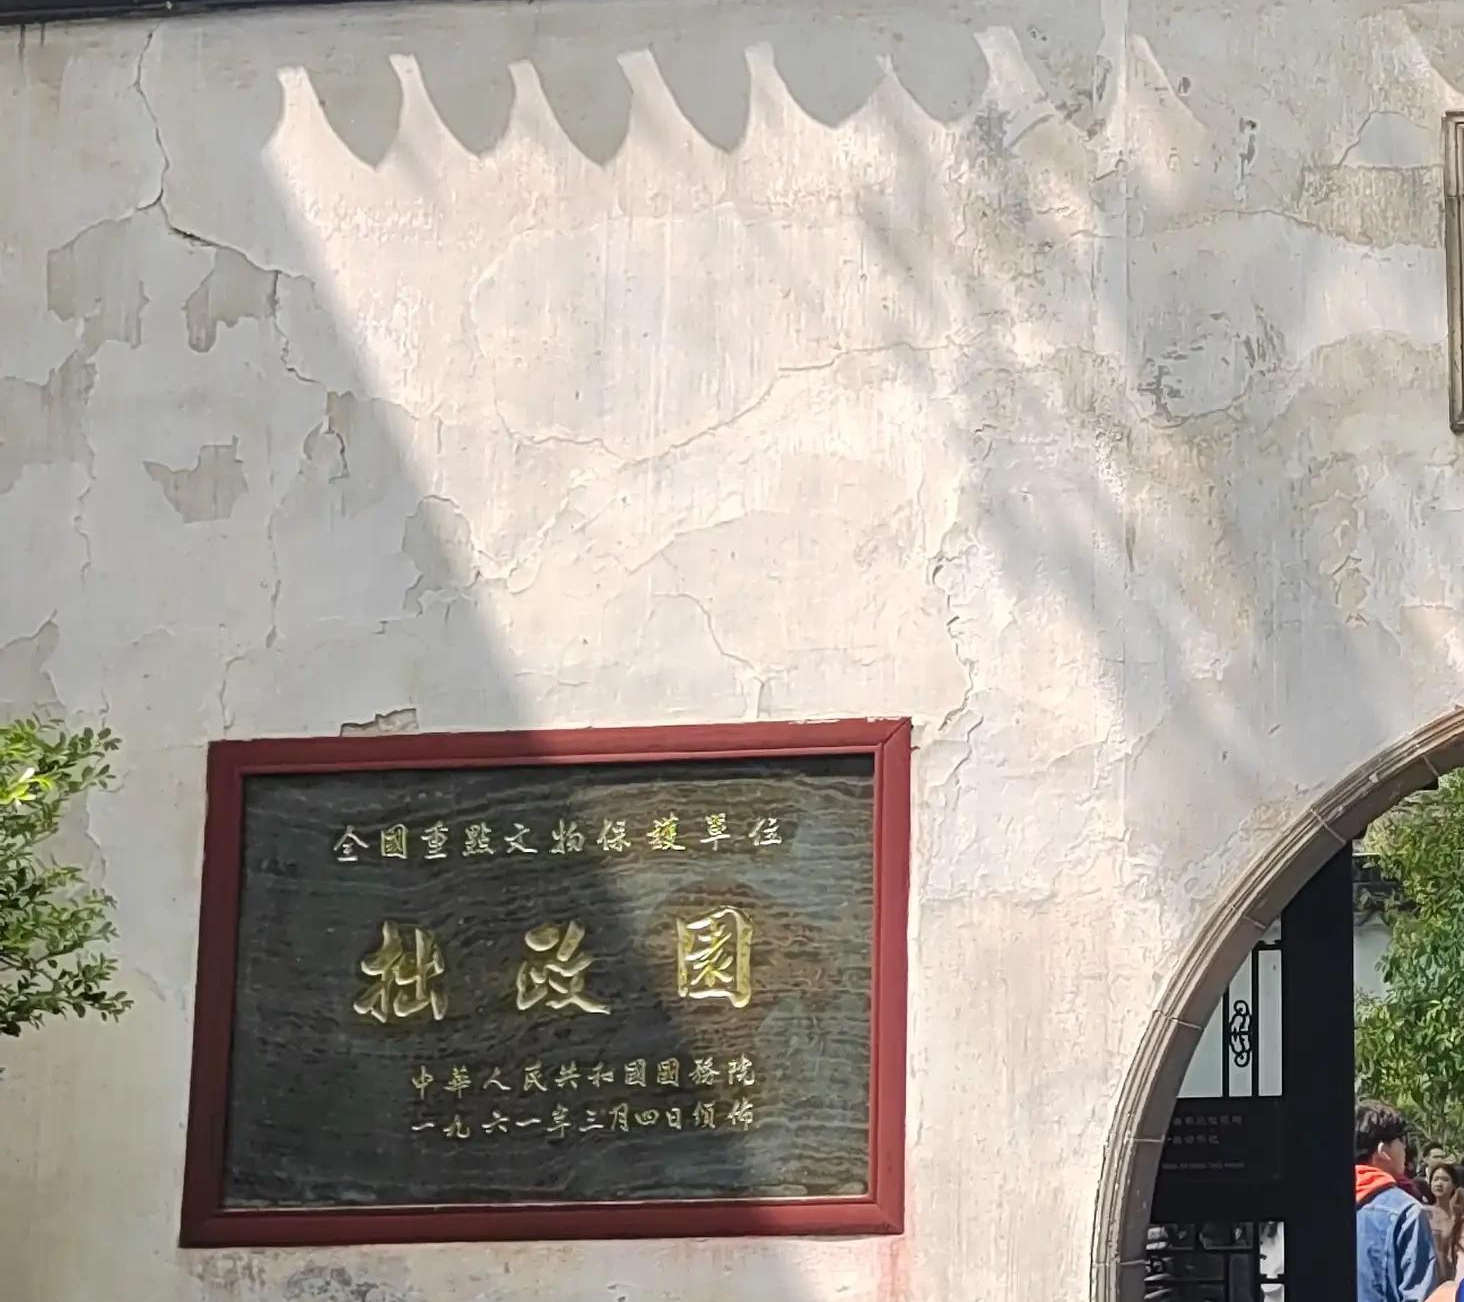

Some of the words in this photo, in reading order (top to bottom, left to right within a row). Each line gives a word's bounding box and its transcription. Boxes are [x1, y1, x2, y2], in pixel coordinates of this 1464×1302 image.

[410, 1054, 758, 1100] 中華人民共和國國務院
